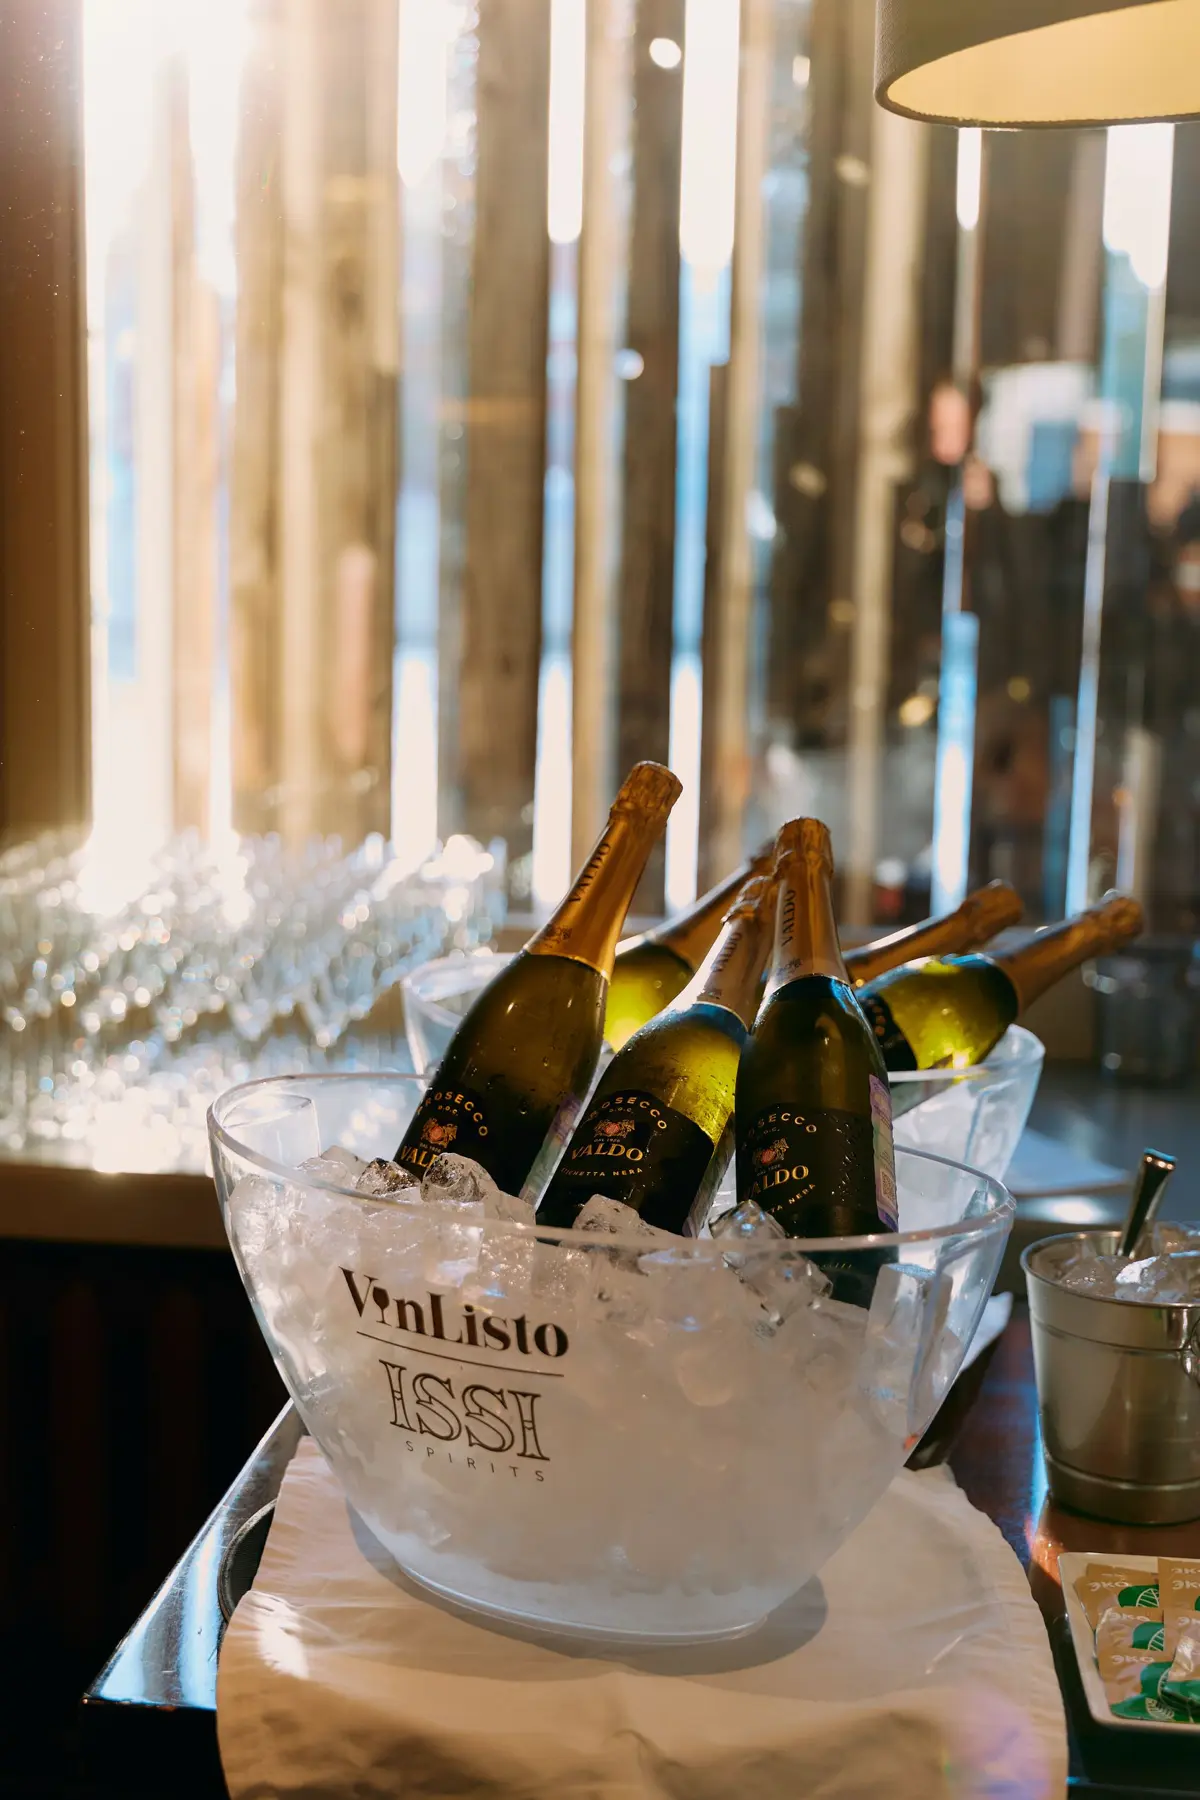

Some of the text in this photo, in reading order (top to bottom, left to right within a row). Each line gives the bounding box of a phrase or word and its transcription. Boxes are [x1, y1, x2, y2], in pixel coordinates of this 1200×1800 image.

[572, 1142, 643, 1161] VALDO
[379, 1359, 551, 1461] ISSI
[405, 1440, 545, 1482] SPIRITS
[1089, 1580, 1129, 1592] ЭКО
[1172, 1580, 1200, 1590] ЭК
[1111, 1654, 1155, 1663] ЭКО
